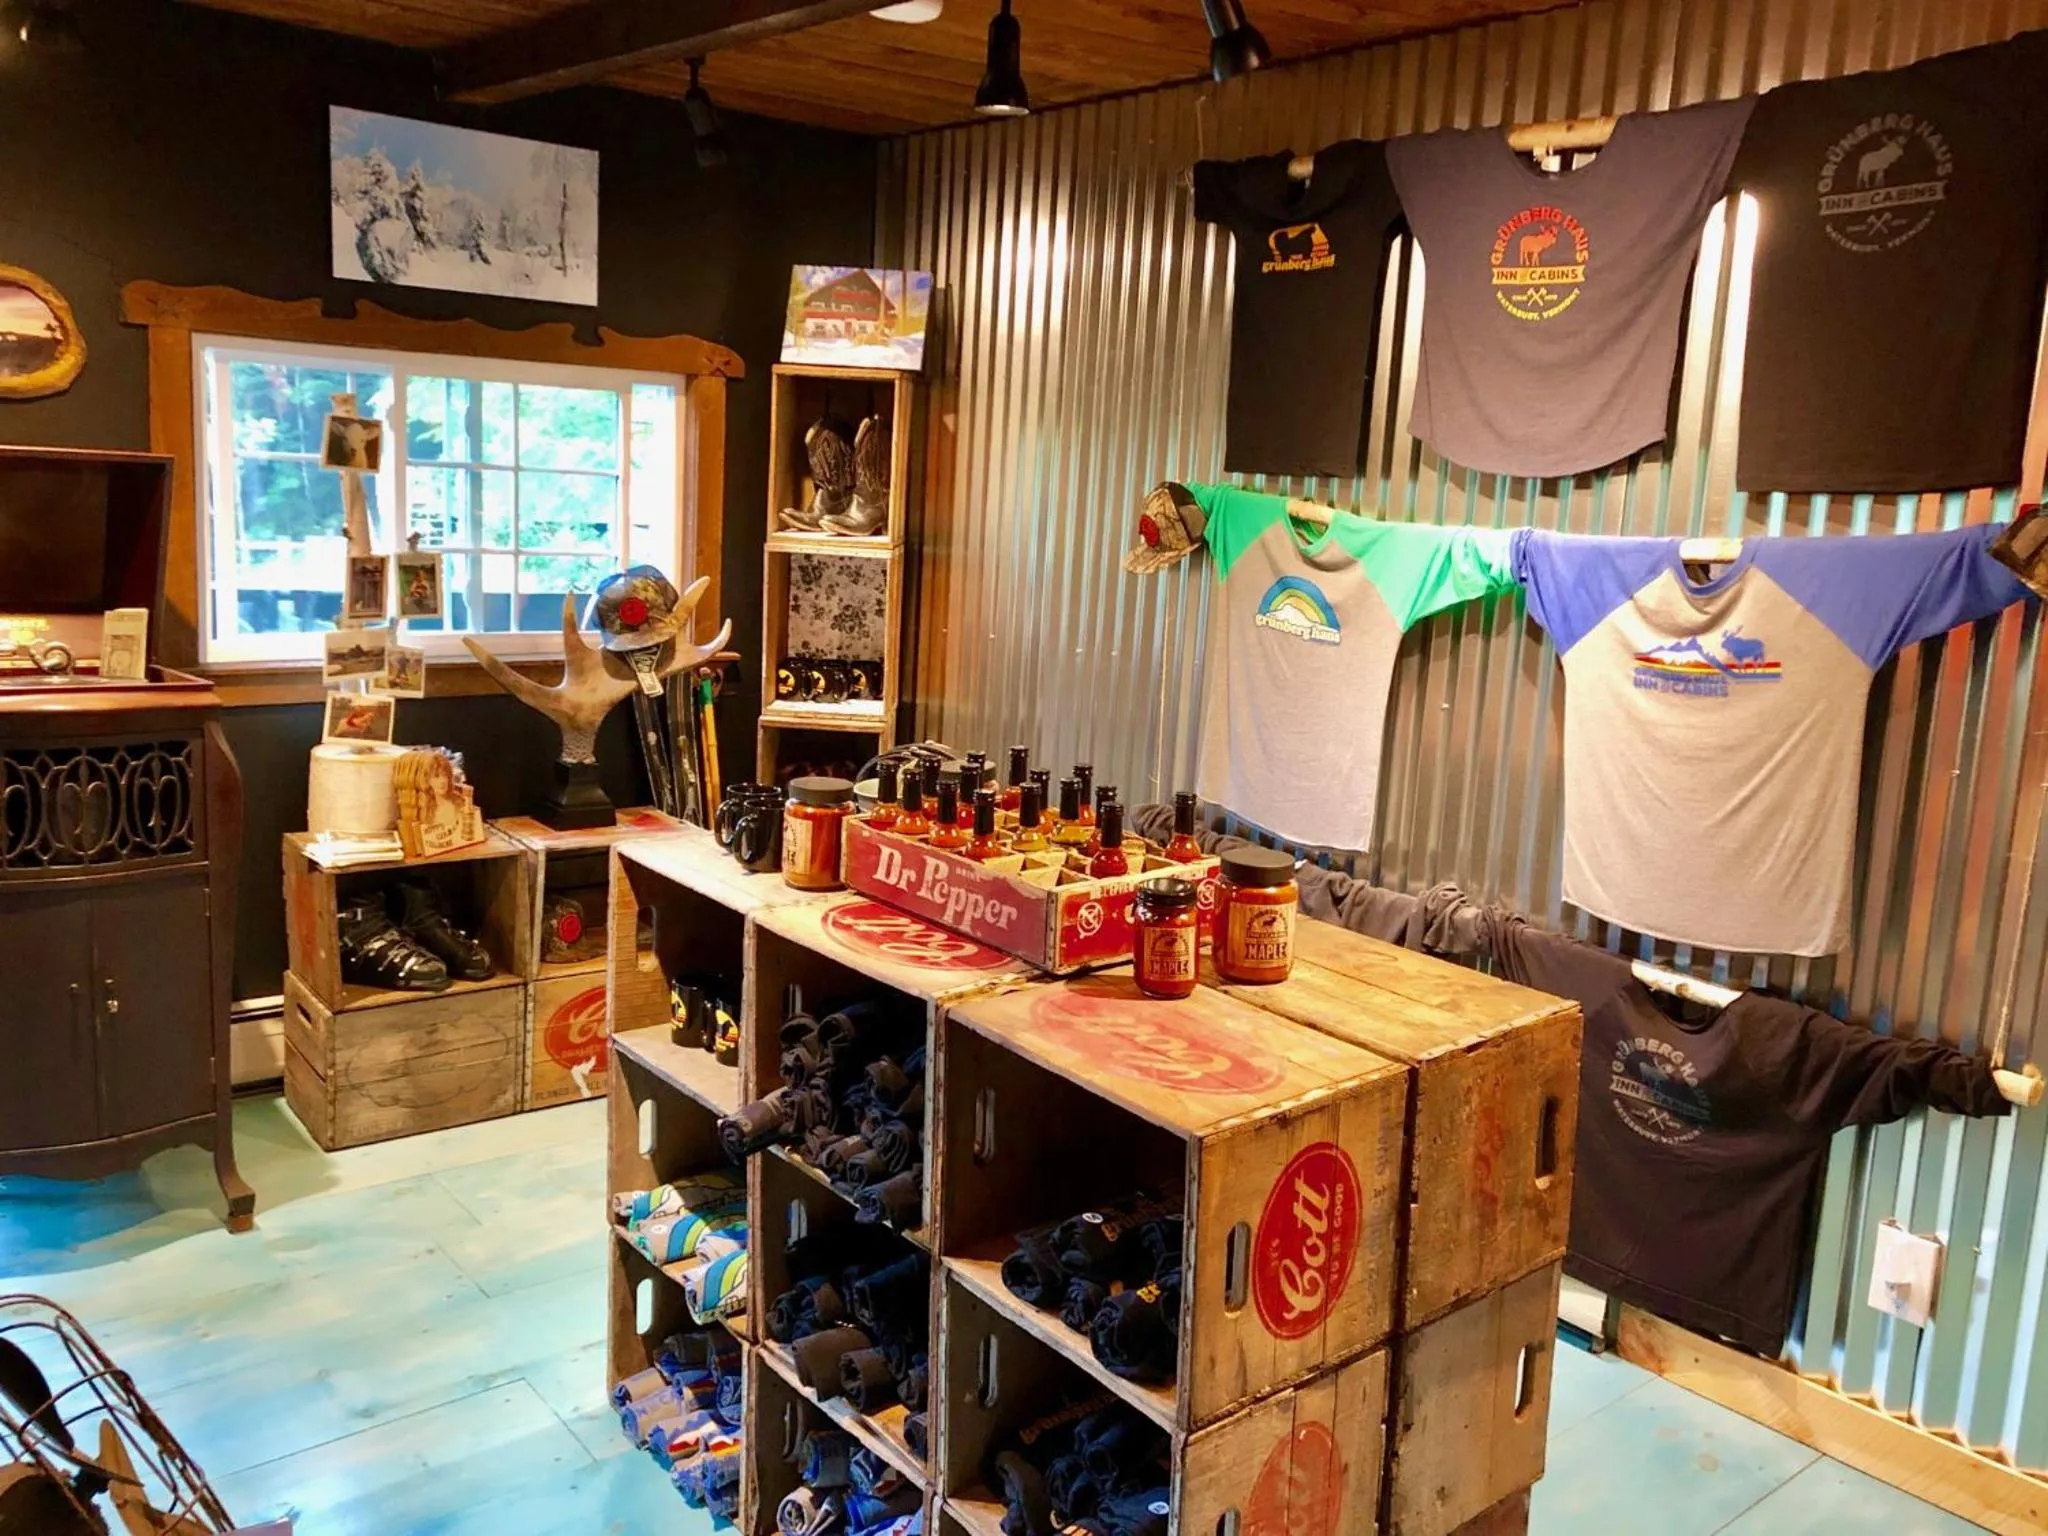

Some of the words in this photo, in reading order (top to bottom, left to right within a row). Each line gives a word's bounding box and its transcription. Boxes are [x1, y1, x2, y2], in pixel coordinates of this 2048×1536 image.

[1915, 120, 1953, 176] HAUS
[1491, 206, 1562, 266] GRÜNBERG
[1563, 215, 1589, 264] HAUS
[1496, 270, 1518, 282] INN
[1529, 268, 1579, 281] CABINS
[872, 843, 917, 893] Dr
[916, 855, 1018, 938] Pepper
[1150, 960, 1189, 975] MAPLE
[1245, 942, 1287, 960] MAPLE
[1614, 1079, 1642, 1097] INN
[1334, 1183, 1344, 1228] GOOD
[1281, 1169, 1330, 1320] Cott
